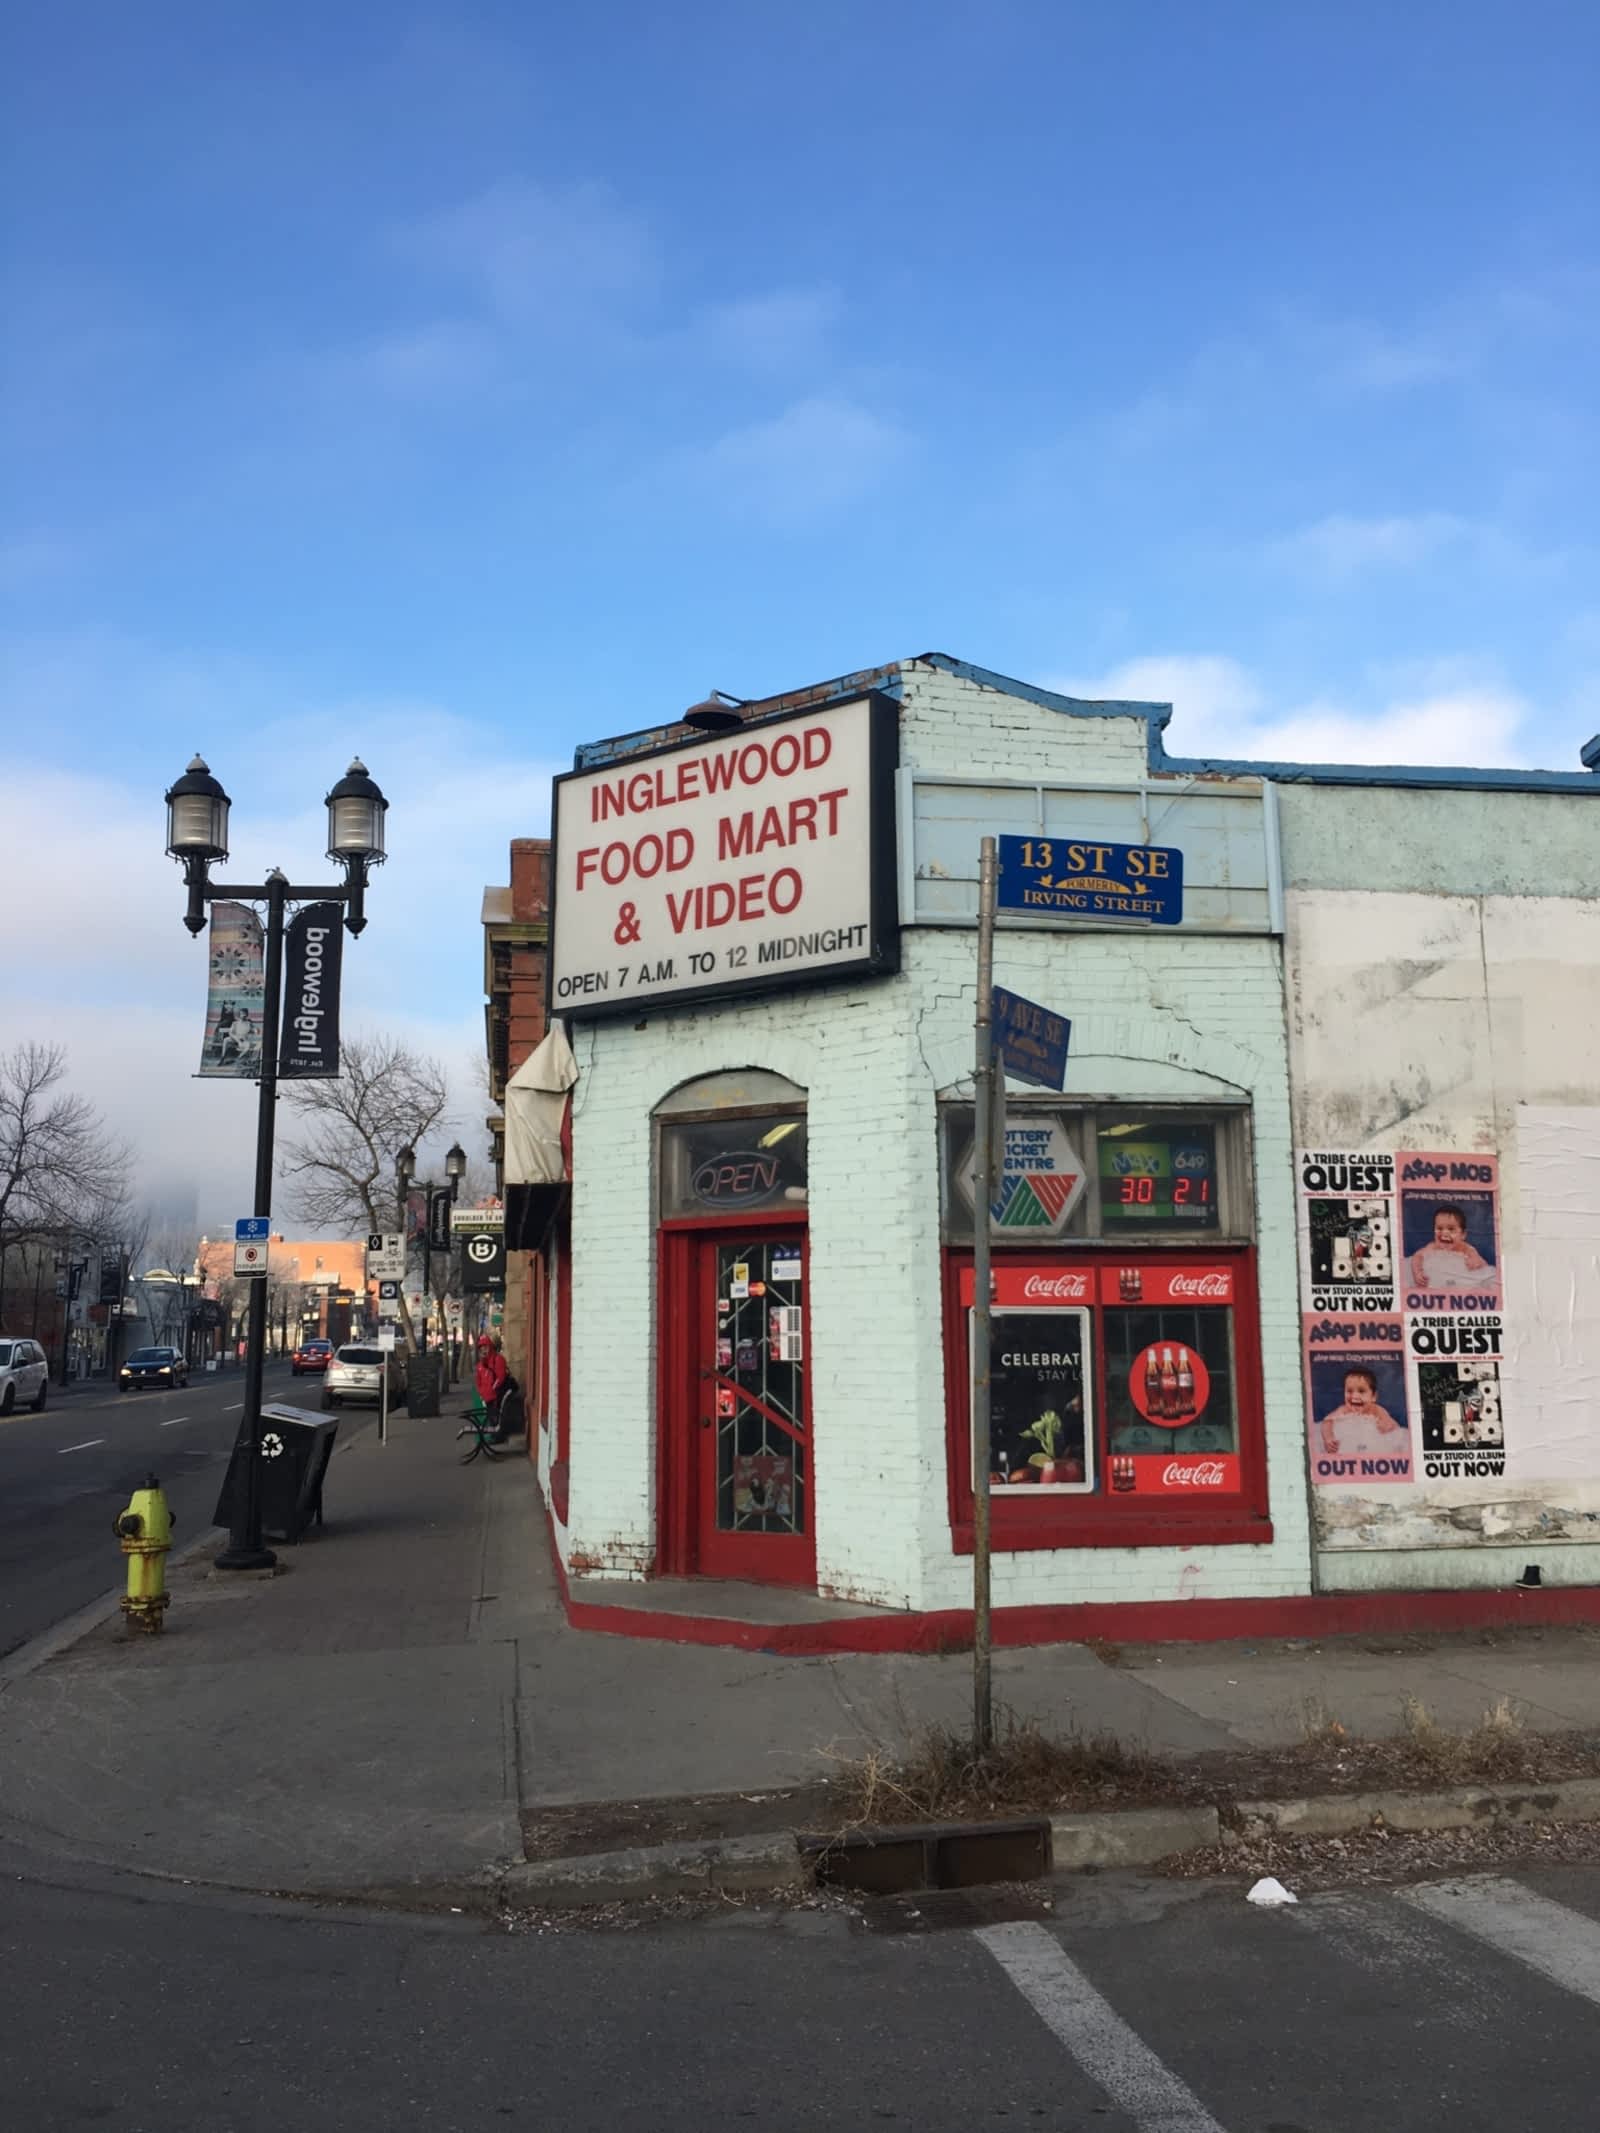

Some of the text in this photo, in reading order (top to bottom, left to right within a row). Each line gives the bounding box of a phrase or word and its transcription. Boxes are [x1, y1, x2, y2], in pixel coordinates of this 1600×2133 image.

[591, 727, 832, 823] INGLEWOOD
[576, 788, 849, 891] FOOD MART
[1020, 841, 1169, 878] 13 ST SE
[1065, 877, 1121, 893] FORMERLY
[614, 867, 803, 945] & VIDEO
[1023, 889, 1165, 914] IRVING STREET
[557, 924, 868, 998] OPEN 7 A.M. TO 12 MIDNIGHT
[1005, 1129, 1053, 1142] TTERY
[1006, 1143, 1048, 1156] ICKET
[1303, 1153, 1393, 1165] A TRIBE CALLED
[1004, 1157, 1055, 1170] ENTRE
[1450, 1162, 1492, 1183] MOB
[695, 1159, 780, 1195] OPEN
[1303, 1165, 1395, 1192] QUEST
[1120, 1177, 1153, 1204] 30
[1174, 1177, 1209, 1204] 21
[1023, 1274, 1089, 1297] Coca-Cola
[1168, 1274, 1232, 1297] Coca-Cola
[1311, 1287, 1394, 1295] NEW STUDIO ALBUM
[1313, 1297, 1394, 1312] OUT NOW
[1406, 1294, 1497, 1310] OUT NOW
[1410, 1316, 1501, 1327] A TRIBE CALLED
[1359, 1322, 1402, 1343] MOB
[1411, 1327, 1503, 1355] QUEST
[1037, 1370, 1069, 1382] STAY
[1423, 1452, 1506, 1461] NEW STUDIO ALBUM
[1162, 1462, 1226, 1486] Coca-Cola
[1317, 1459, 1409, 1476] OUT NOW
[1425, 1461, 1506, 1478] OUT NOW
